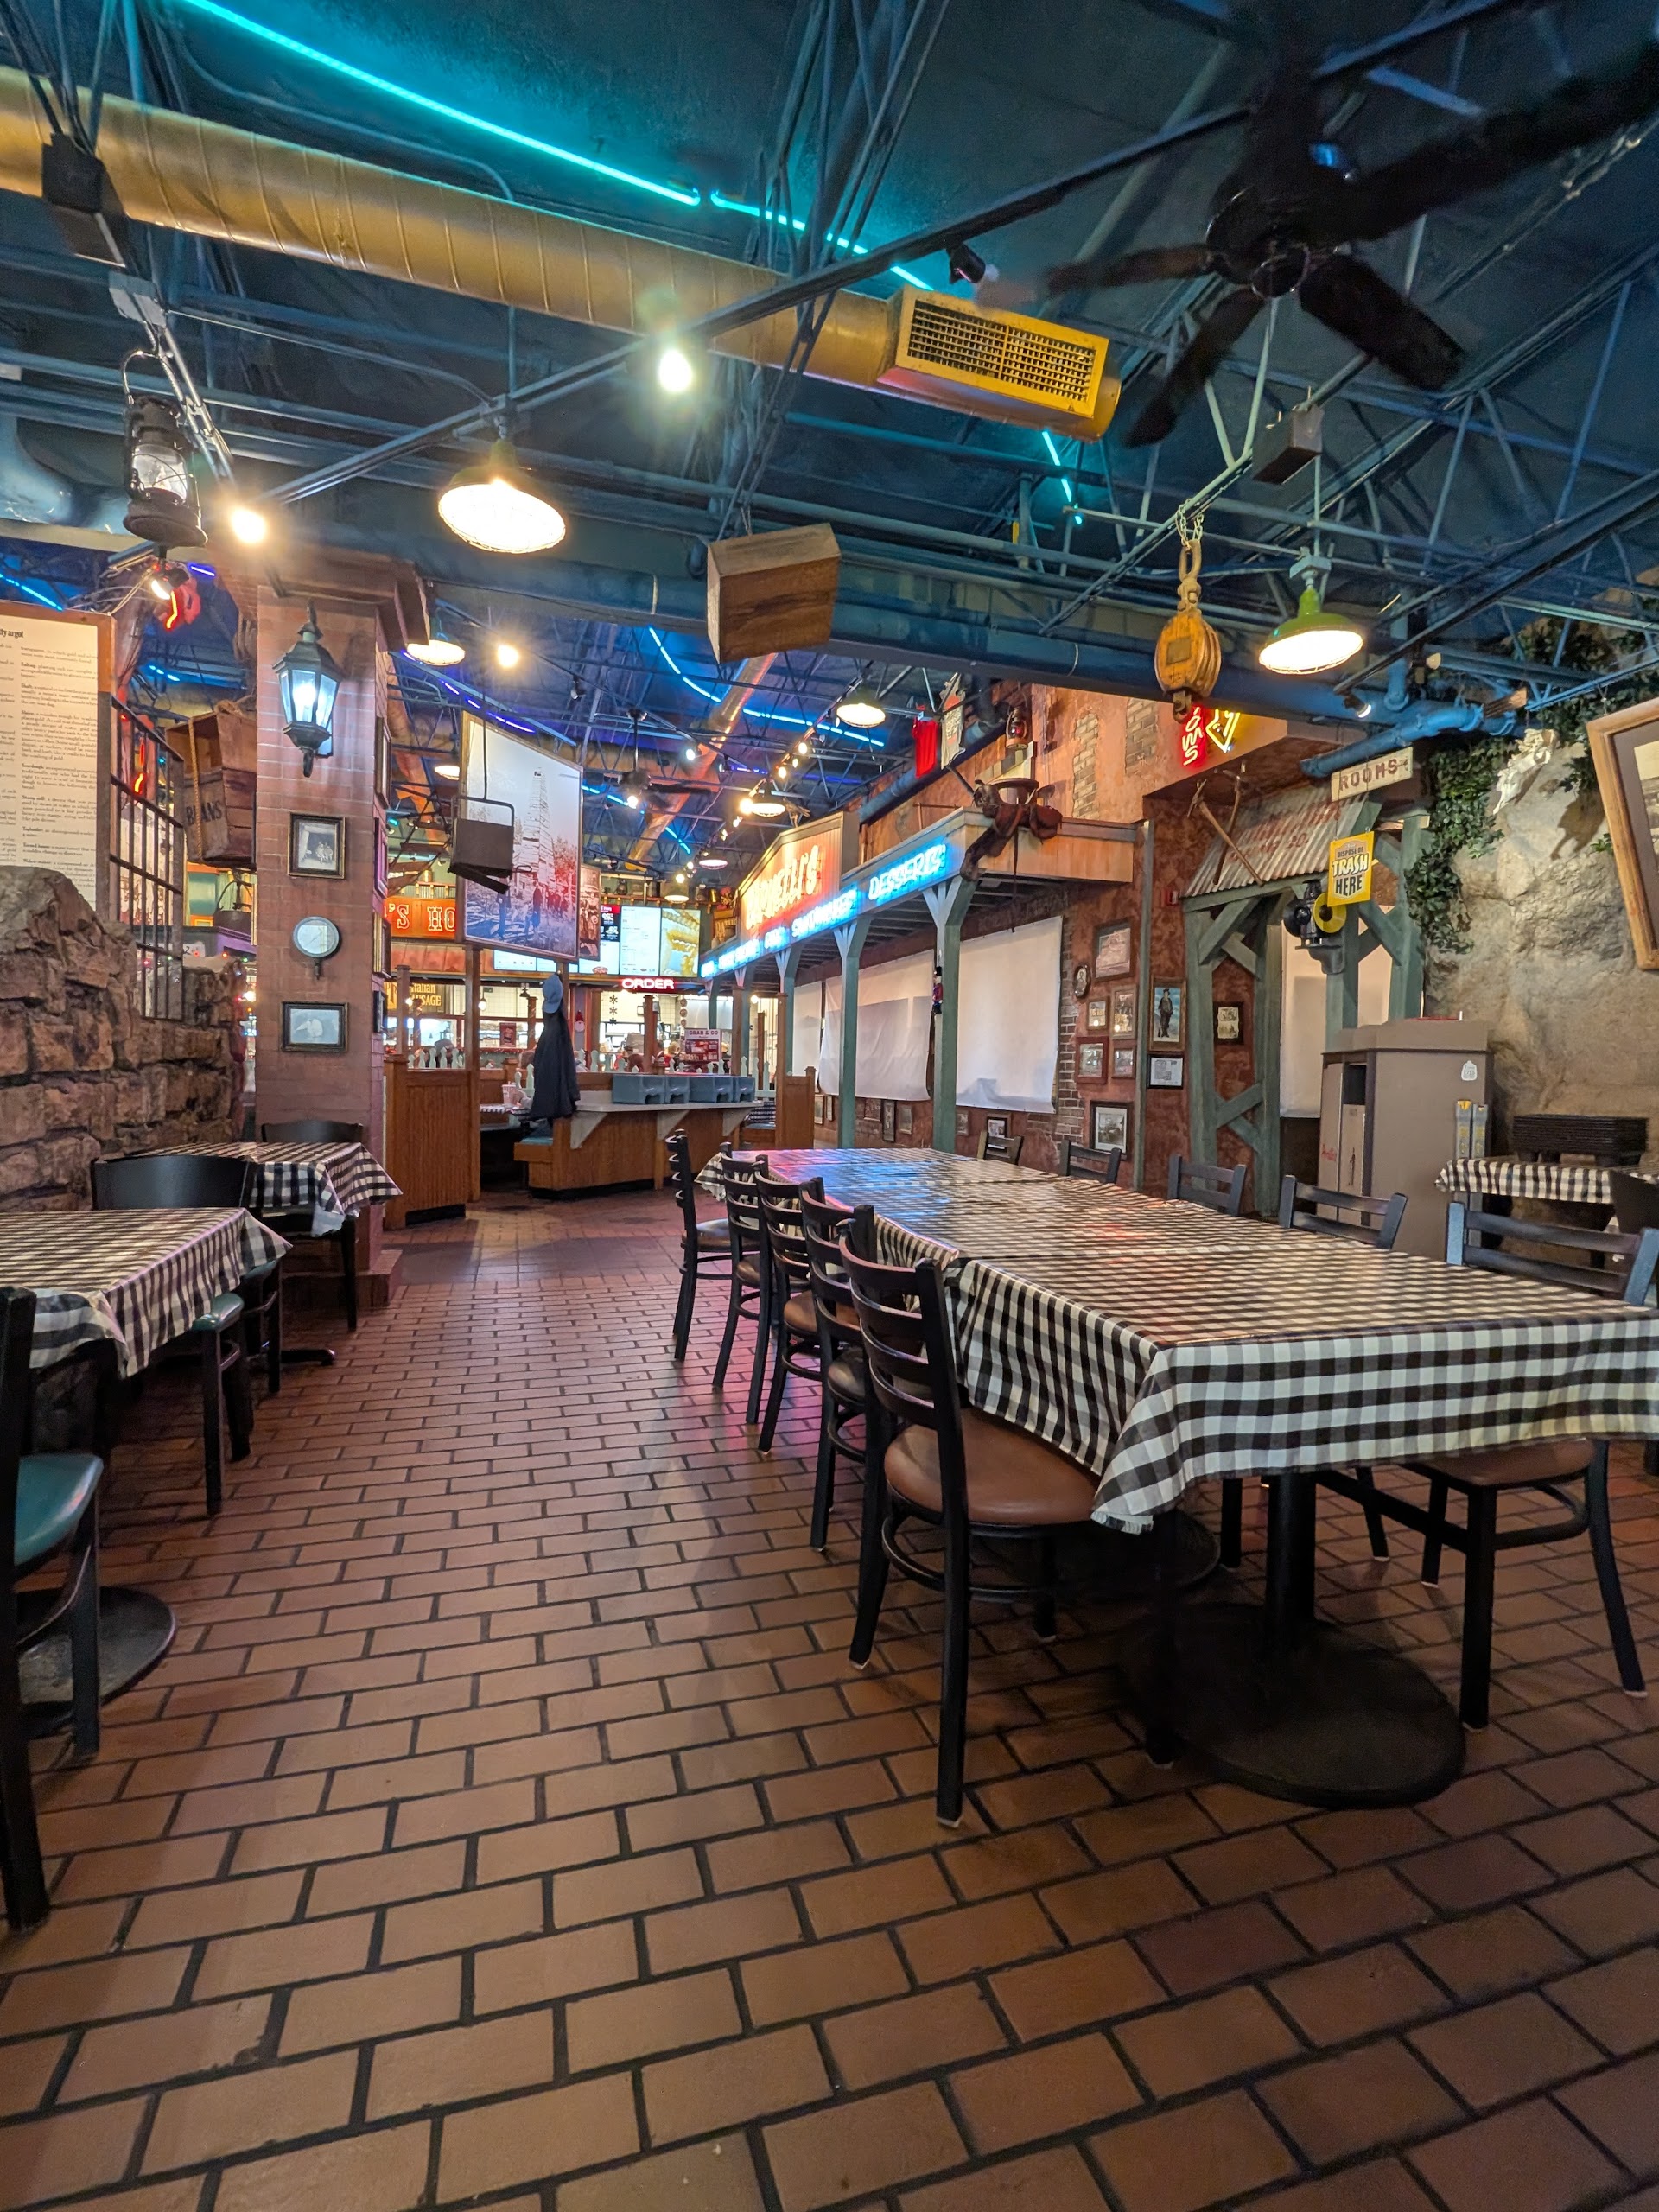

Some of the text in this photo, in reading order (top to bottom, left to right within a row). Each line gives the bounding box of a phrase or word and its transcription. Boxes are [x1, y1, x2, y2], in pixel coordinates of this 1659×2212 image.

[1339, 758, 1397, 791] ROOMS
[186, 800, 223, 827] BANS
[1337, 848, 1357, 858] DISPOSE
[1332, 853, 1369, 877] TRASH
[1335, 874, 1363, 896] HERE
[621, 978, 674, 990] ORDER
[411, 995, 442, 1006] SAGE
